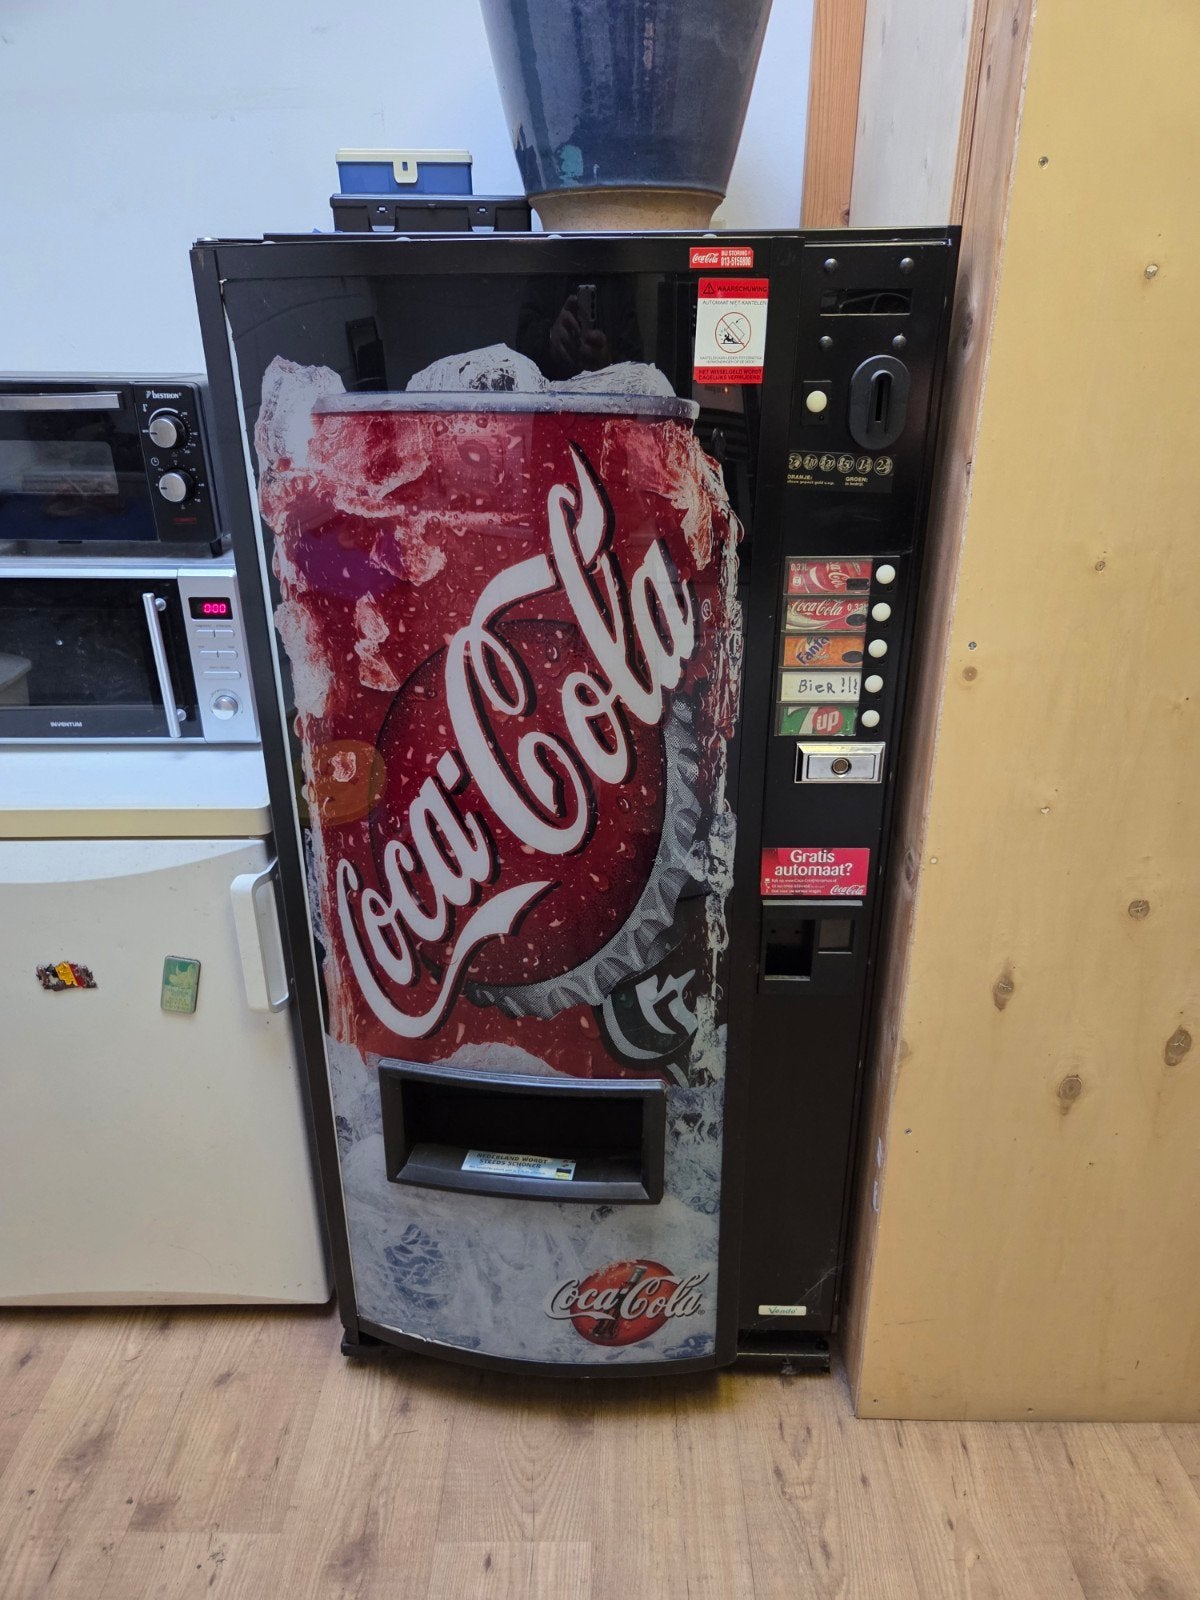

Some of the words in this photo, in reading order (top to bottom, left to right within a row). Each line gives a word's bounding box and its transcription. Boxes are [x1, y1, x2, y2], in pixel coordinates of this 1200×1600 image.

[791, 599, 843, 616] Coca-Cola
[796, 636, 830, 665] Fanta
[336, 440, 697, 1040] Coca-Cola
[790, 849, 835, 863] Gratis
[774, 863, 853, 876] automaat?
[830, 884, 865, 896] Coca-Cola
[476, 1152, 520, 1161] NEDERLAND
[522, 1156, 549, 1164] WORDT
[507, 1160, 542, 1169] SCHONER
[544, 1271, 710, 1321] Coca-Cola
